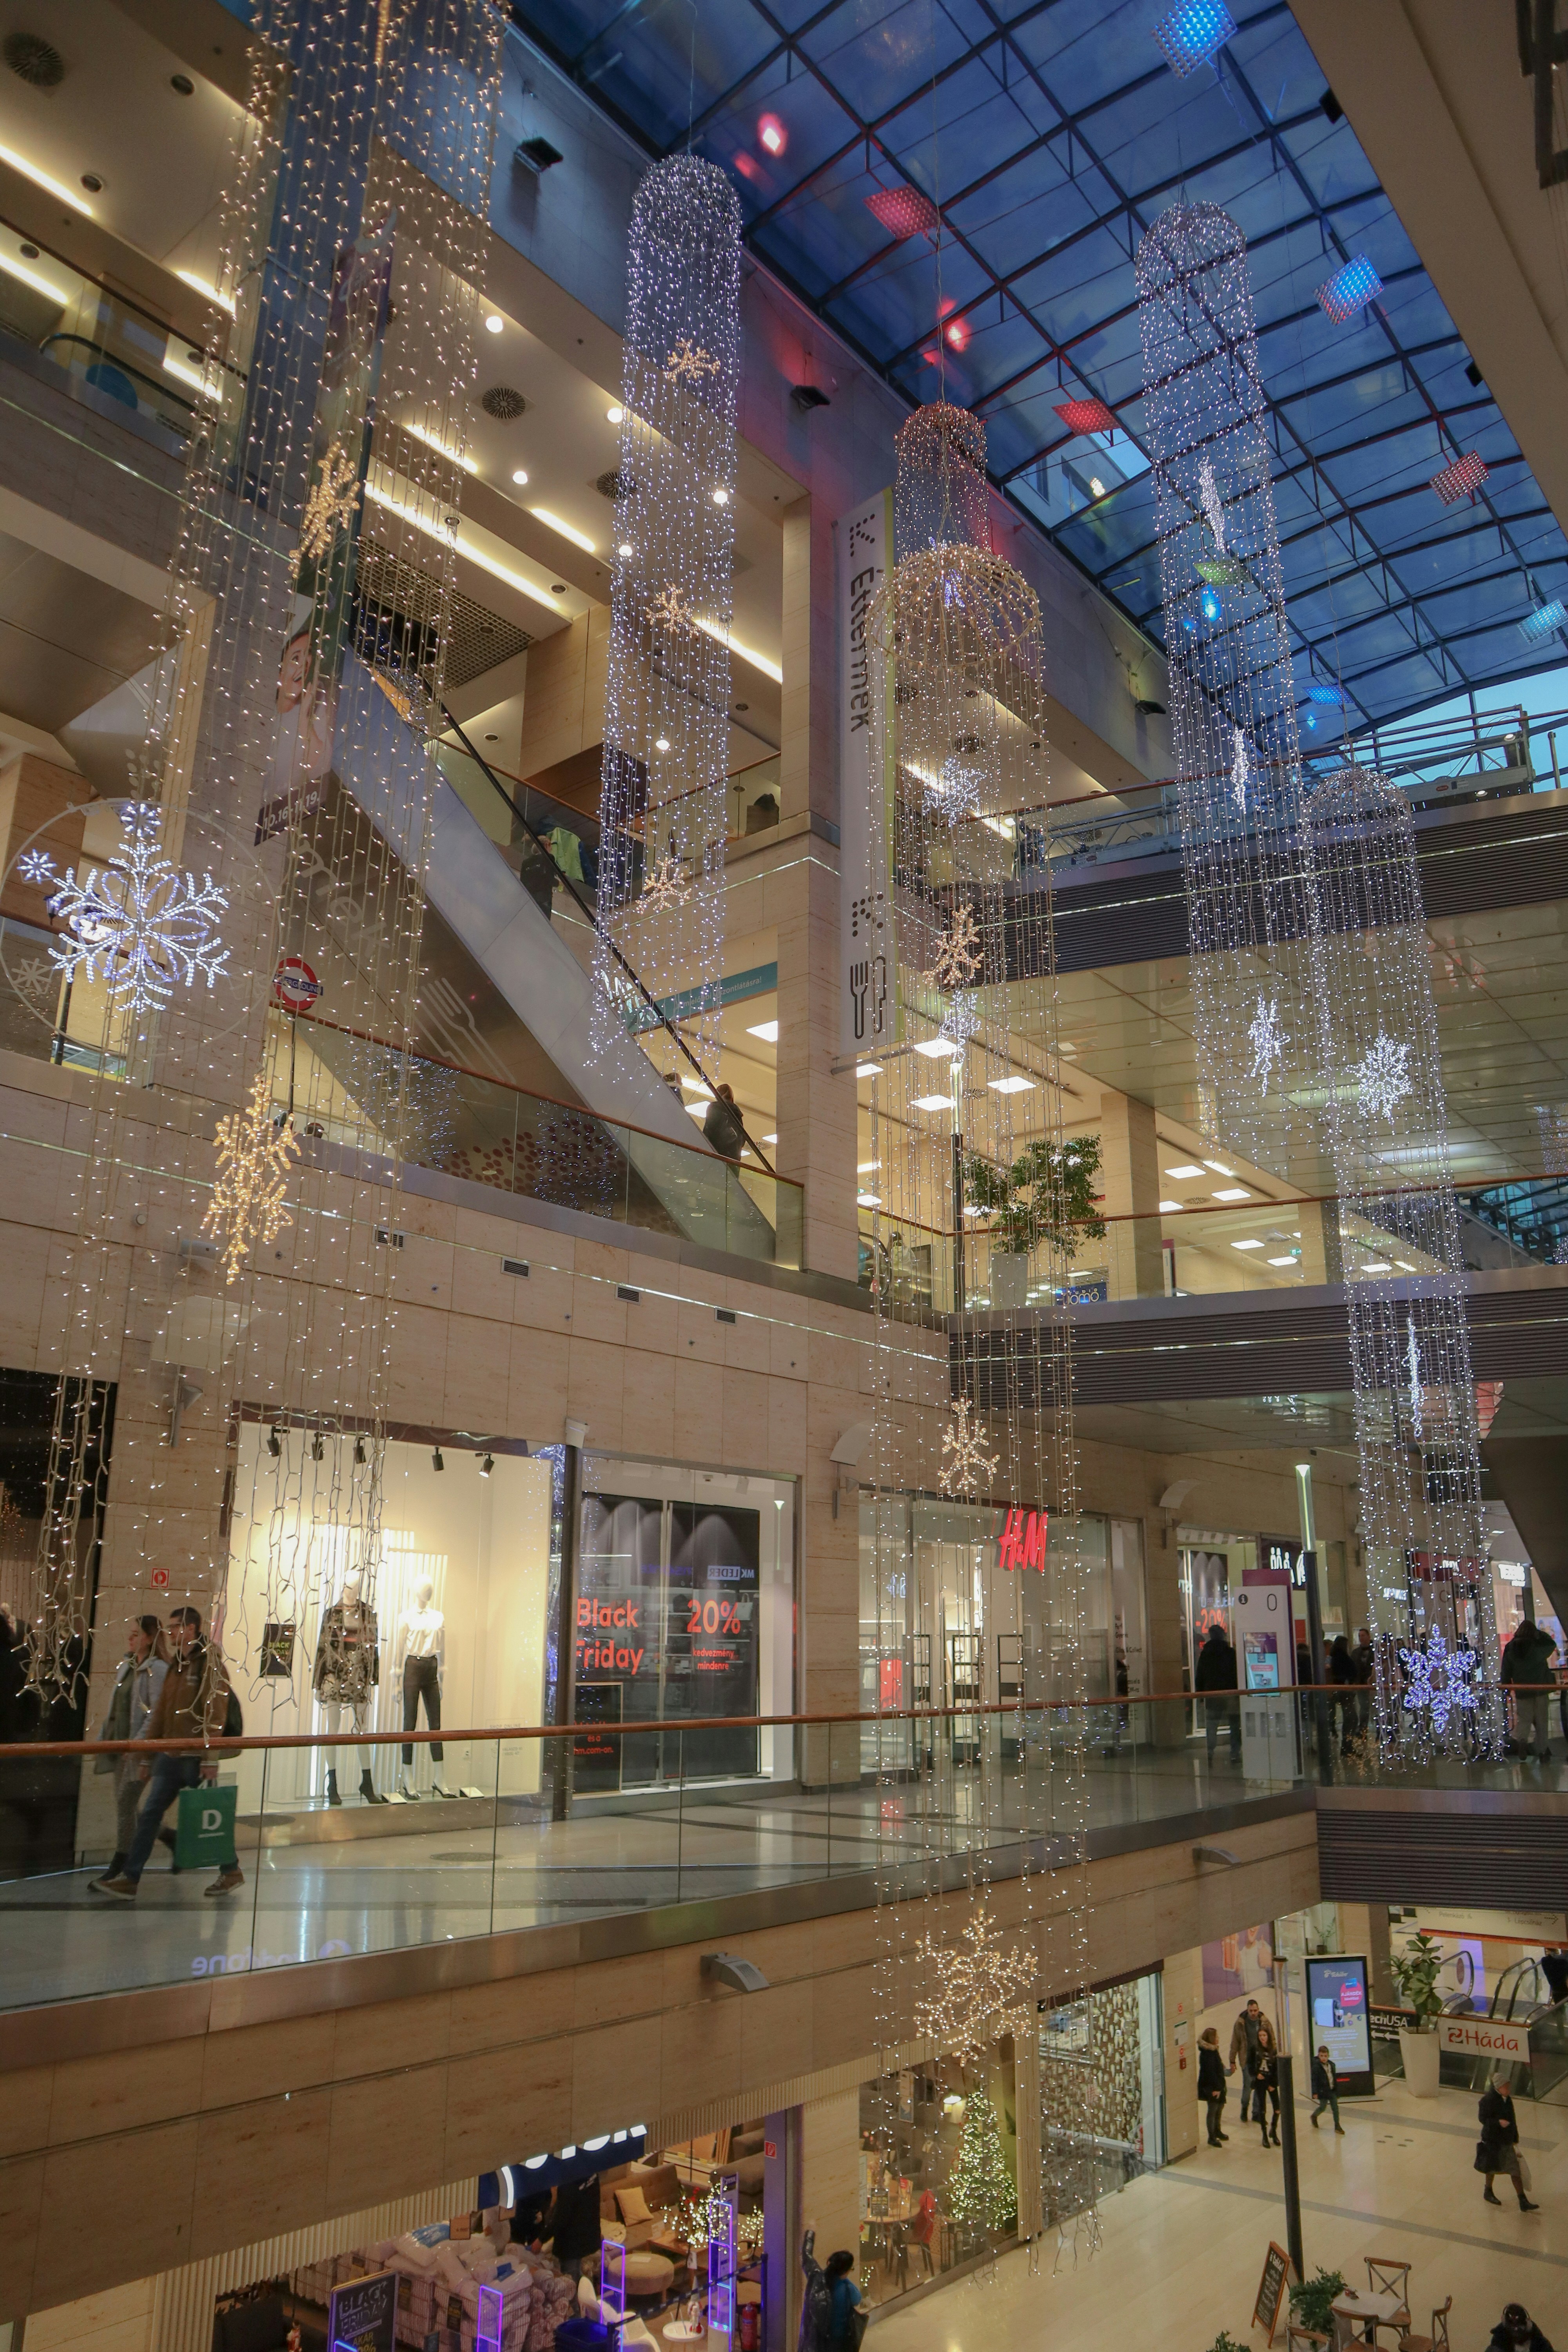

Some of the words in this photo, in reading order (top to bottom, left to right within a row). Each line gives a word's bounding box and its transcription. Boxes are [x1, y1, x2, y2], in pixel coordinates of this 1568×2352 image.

[998, 1508, 1048, 1573] H&M
[577, 1597, 639, 1628] Black
[687, 1600, 741, 1634] 20%
[1195, 1608, 1228, 1634] -20%
[576, 1640, 644, 1675] Friday
[692, 1647, 735, 1659] kedvezmény
[697, 1661, 729, 1670] mindenre
[201, 1809, 222, 1831] D
[1369, 2014, 1408, 2029] echUSA
[1465, 2029, 1519, 2052] Háda
